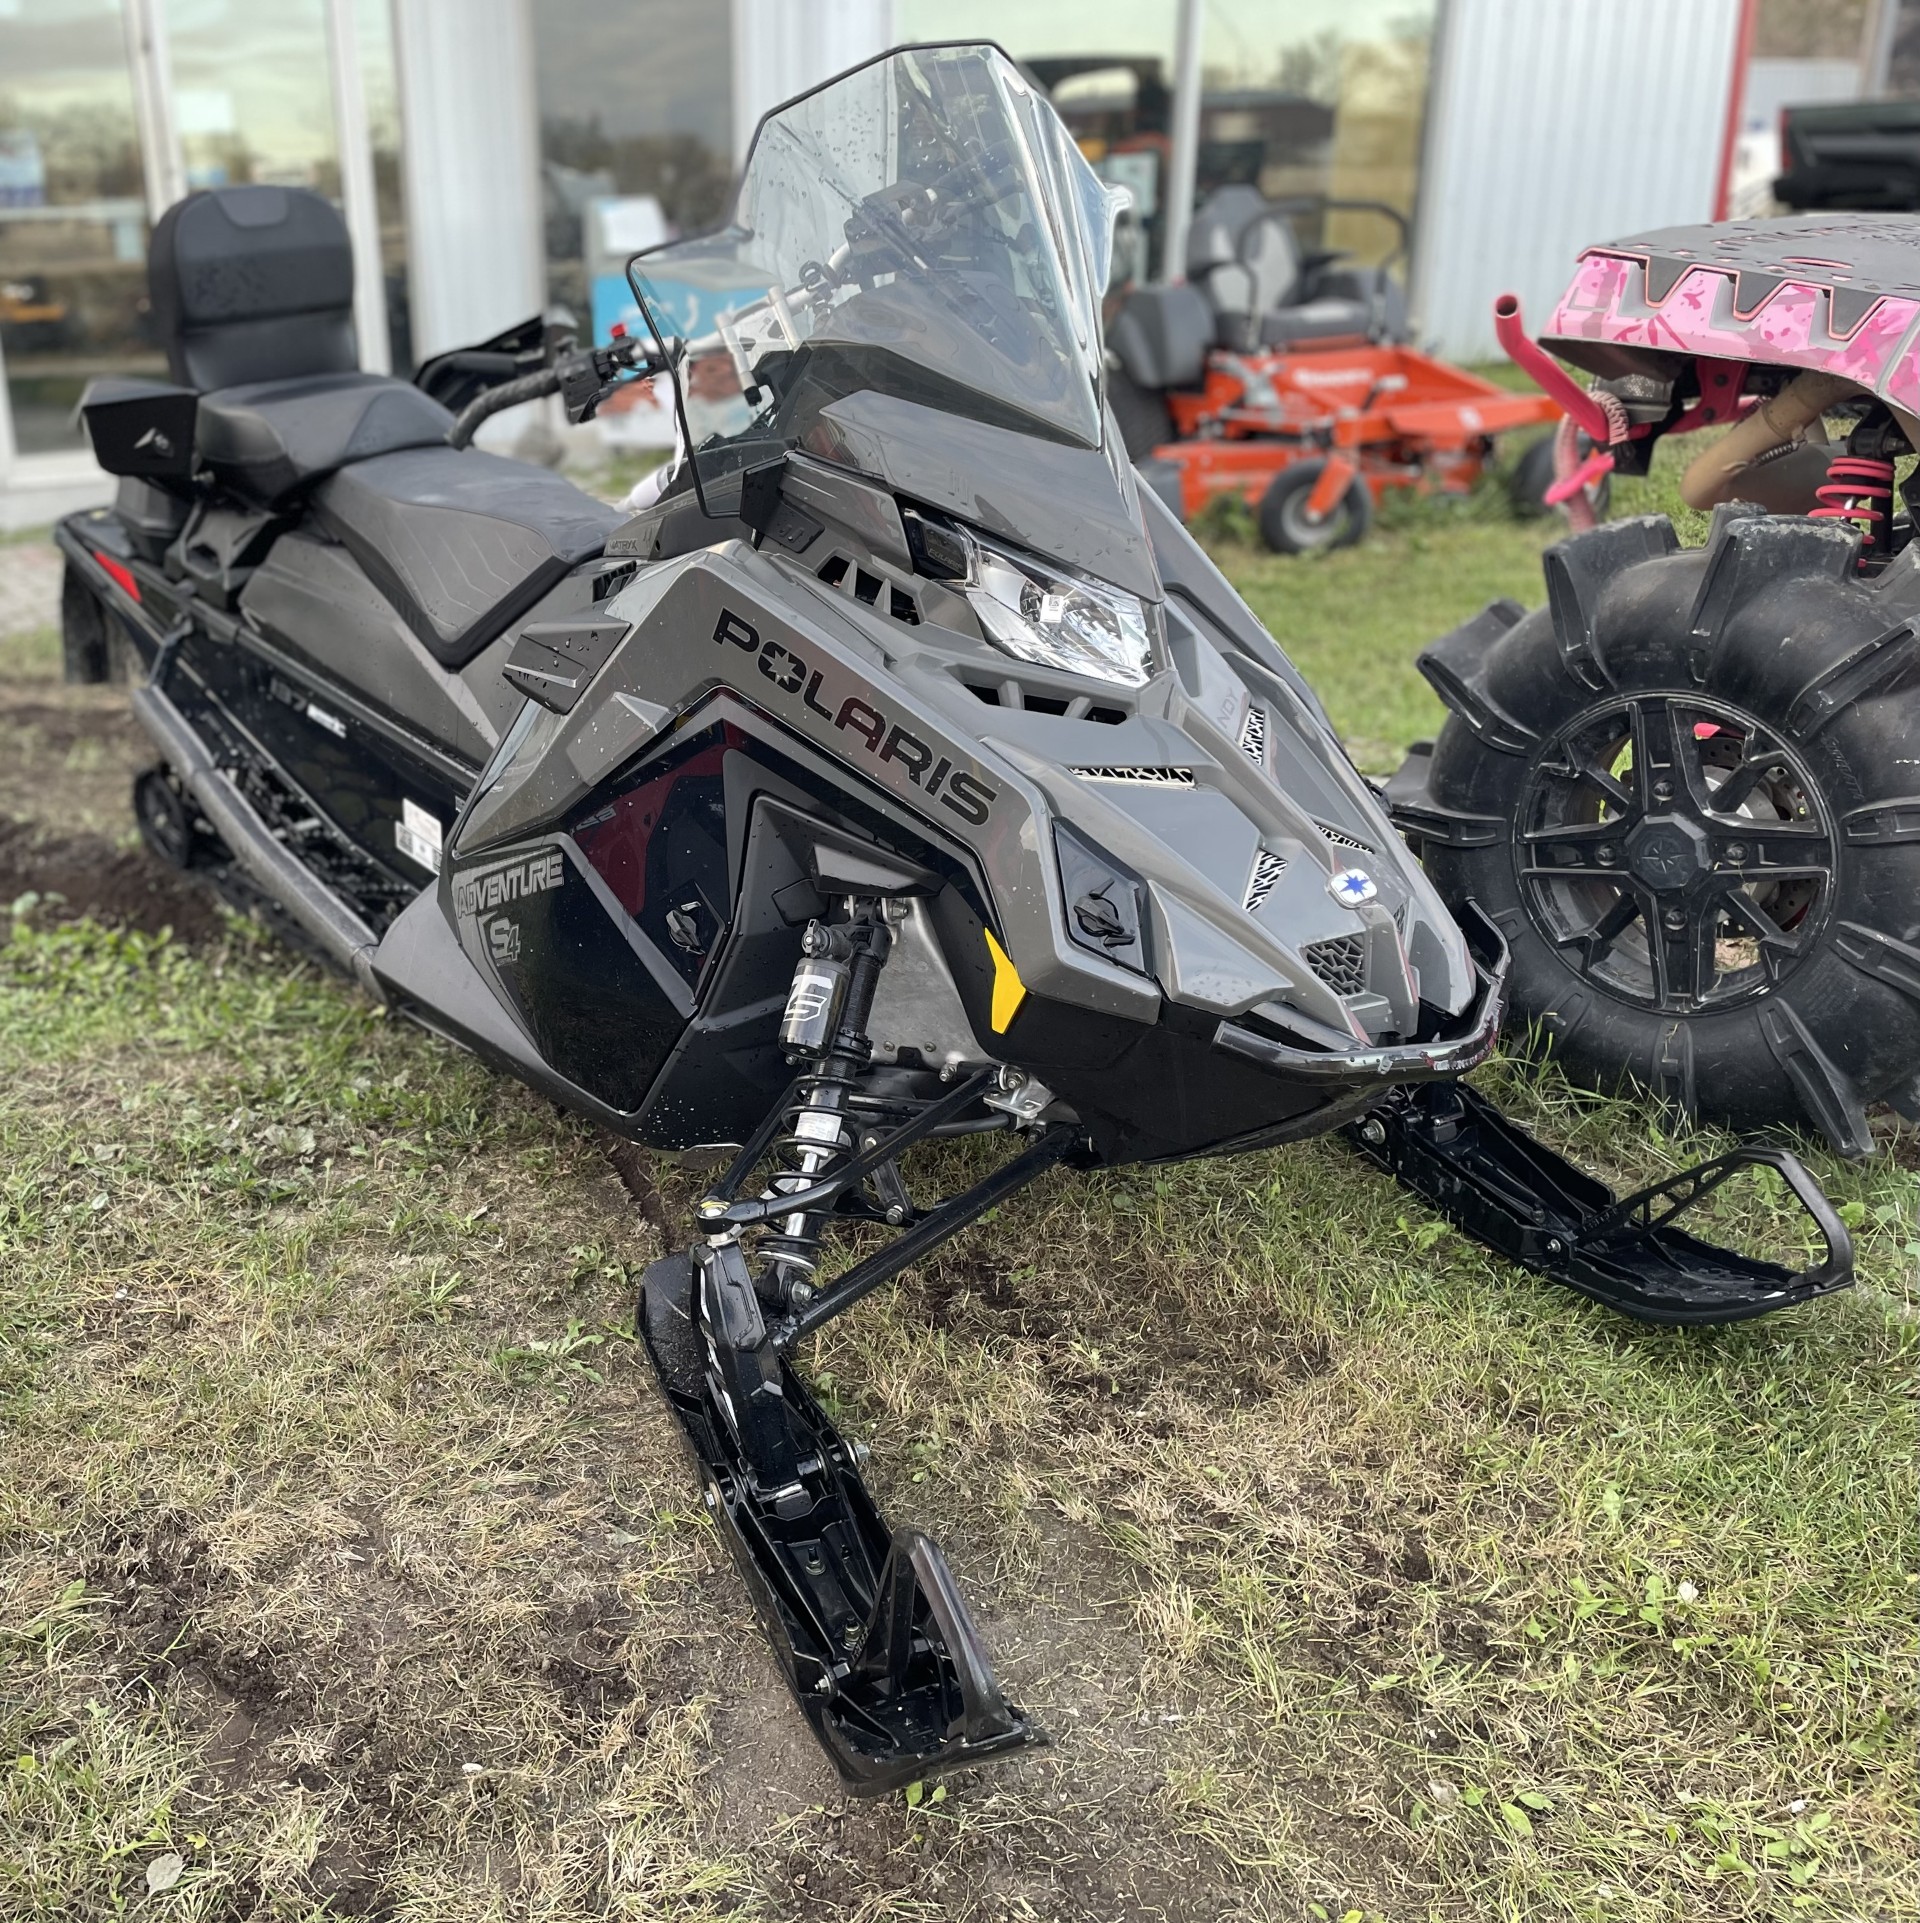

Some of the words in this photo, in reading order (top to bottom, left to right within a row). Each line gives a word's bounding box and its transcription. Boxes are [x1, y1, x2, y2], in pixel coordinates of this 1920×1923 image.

[712, 607, 998, 826] POLARIS
[458, 852, 565, 919] ADVENTURE
[489, 916, 521, 961] S4
